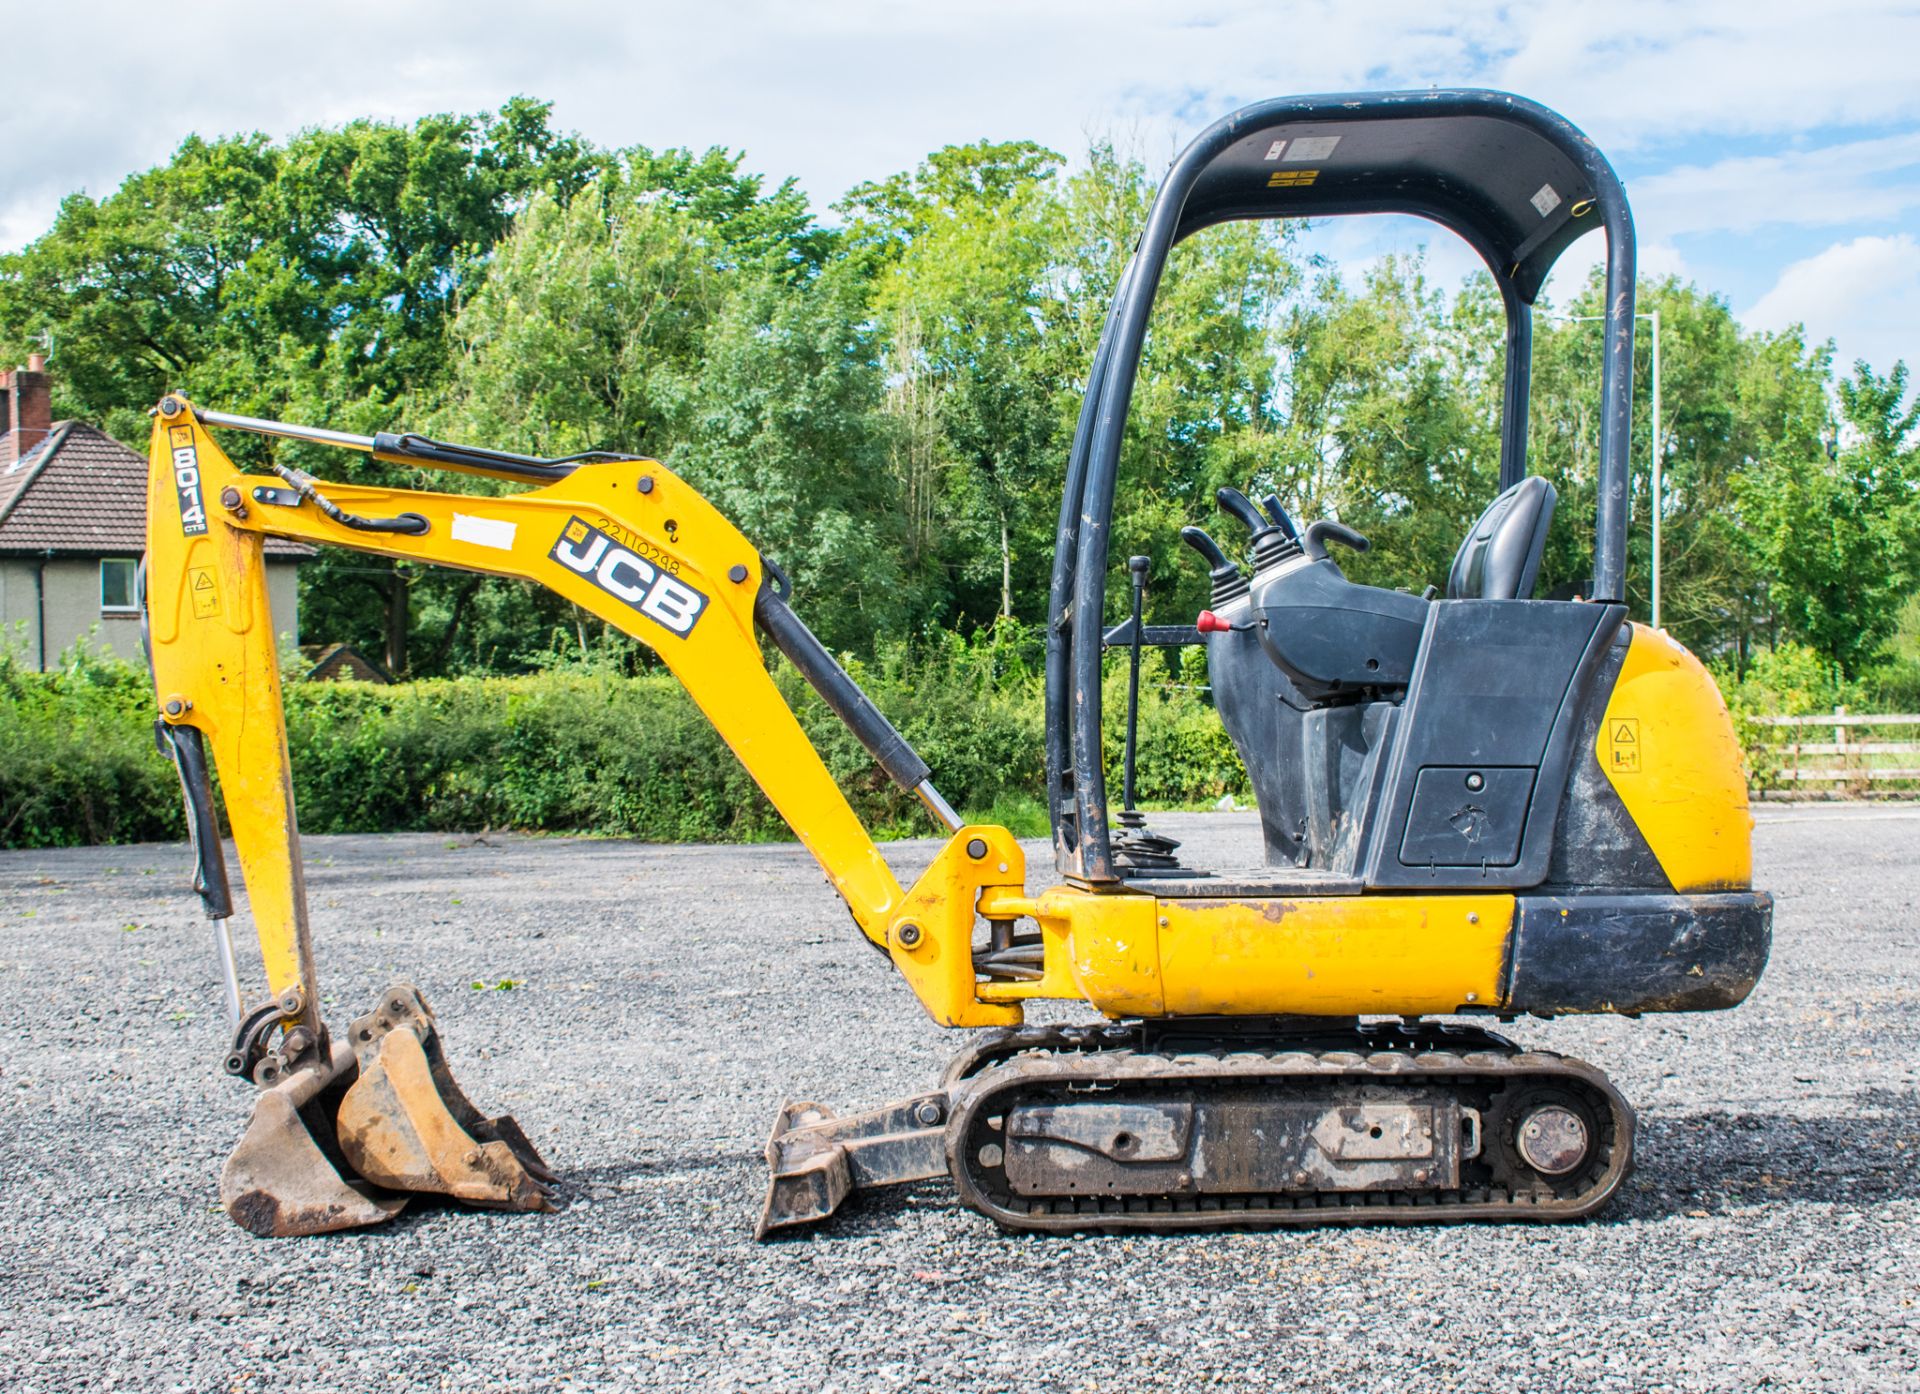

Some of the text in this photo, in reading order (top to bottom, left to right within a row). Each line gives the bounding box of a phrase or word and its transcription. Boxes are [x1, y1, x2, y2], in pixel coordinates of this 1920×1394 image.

[173, 447, 205, 524] 8014
[556, 534, 702, 632] JCB
[598, 518, 680, 576] 22110298
